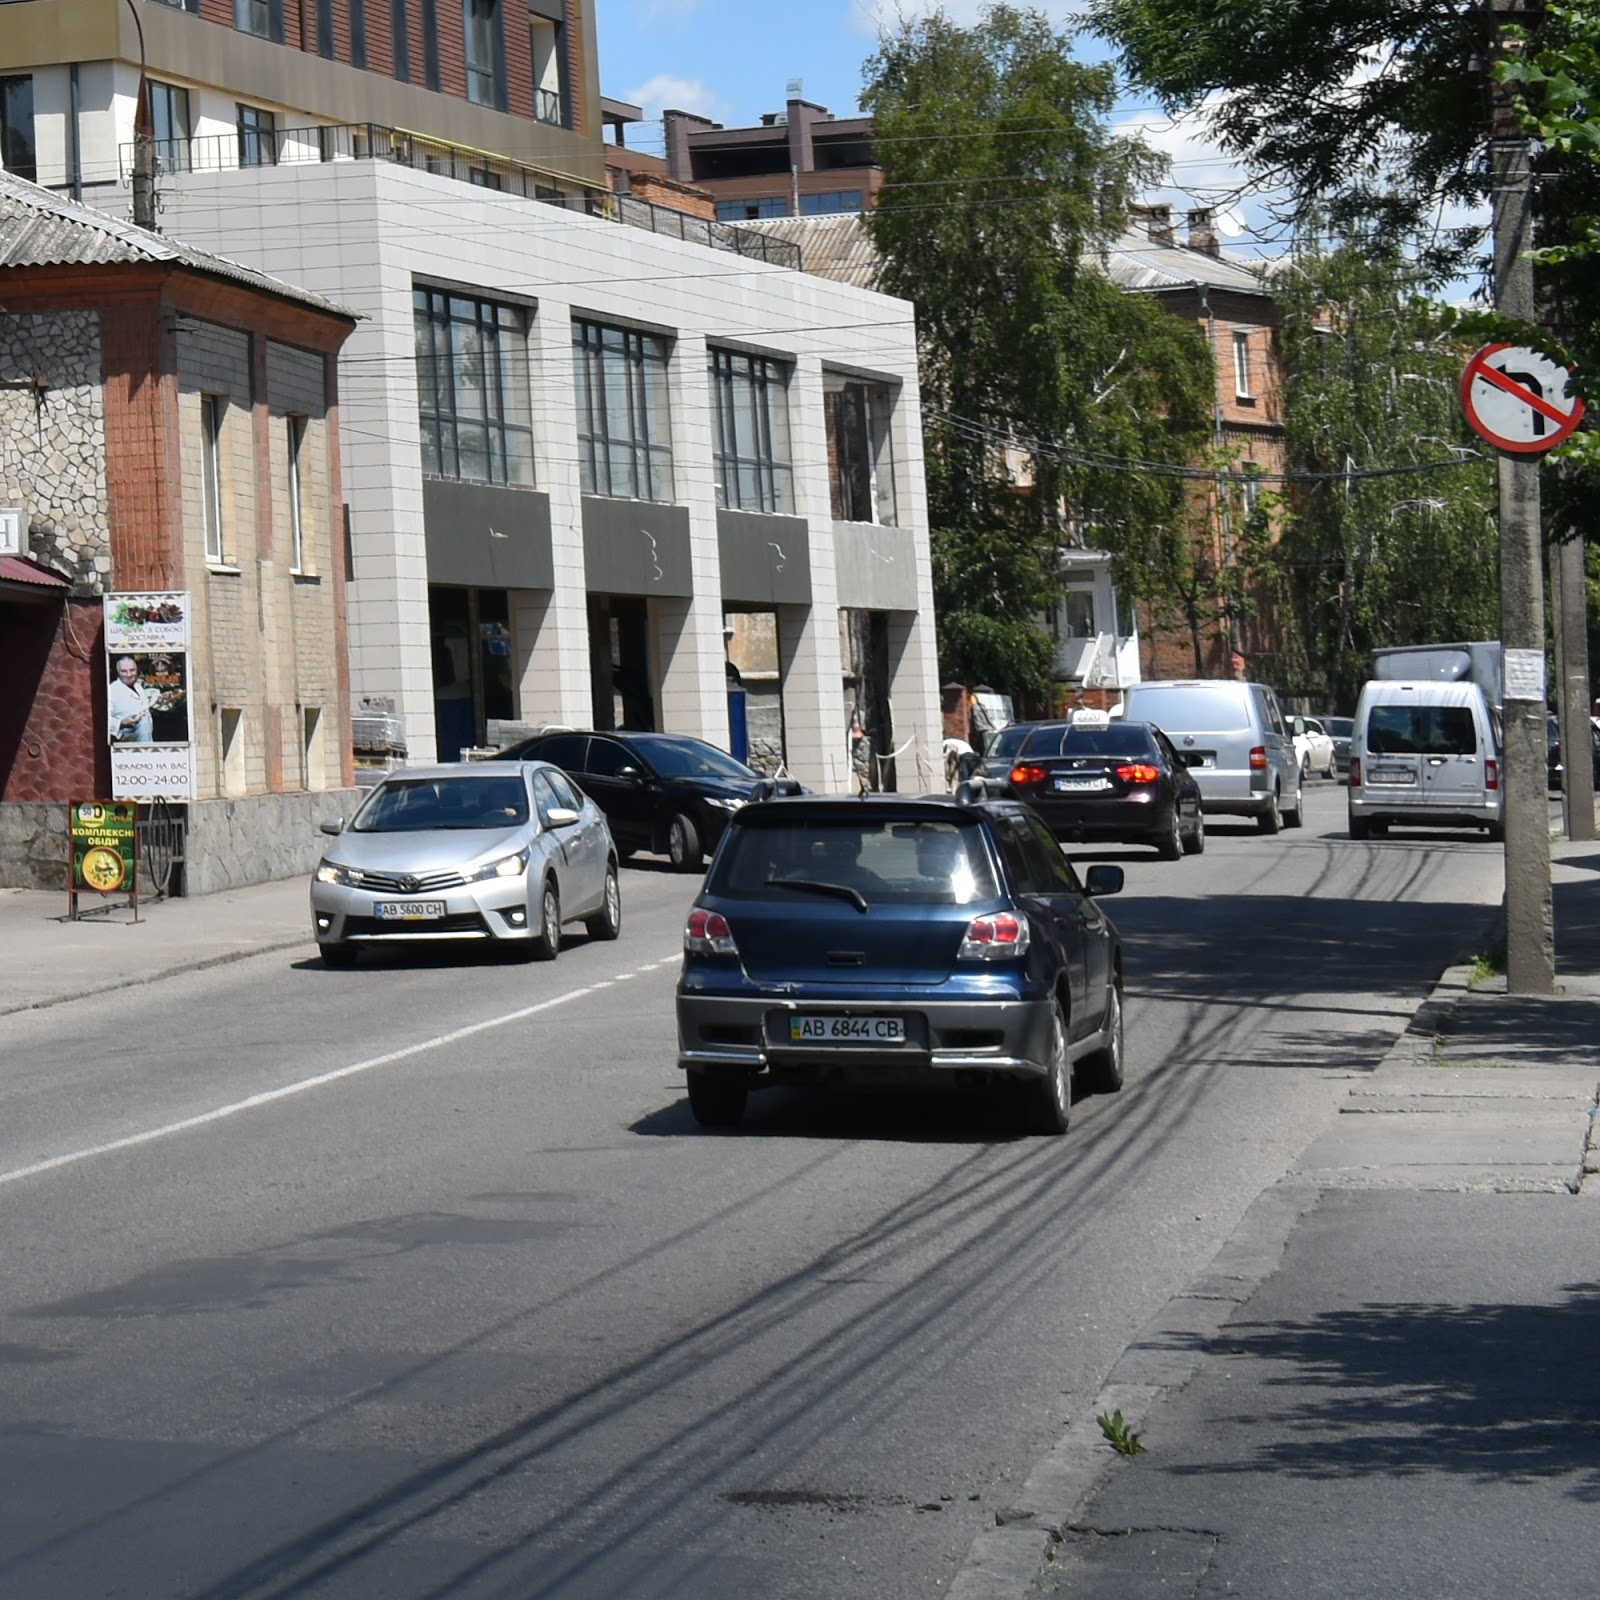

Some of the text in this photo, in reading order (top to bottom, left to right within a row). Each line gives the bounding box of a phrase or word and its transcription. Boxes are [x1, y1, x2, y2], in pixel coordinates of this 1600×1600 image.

[155, 625, 184, 633] СОБОЮ
[128, 634, 166, 642] ДОСТАВКА
[115, 763, 153, 771] ЧЕКАЄМО
[170, 762, 187, 770] ВАС
[72, 827, 135, 838] КОМПЛЕКСНІ
[87, 837, 119, 847] ОБІДИ
[426, 903, 442, 914] CH
[802, 1019, 899, 1037] AB 6844 CB
